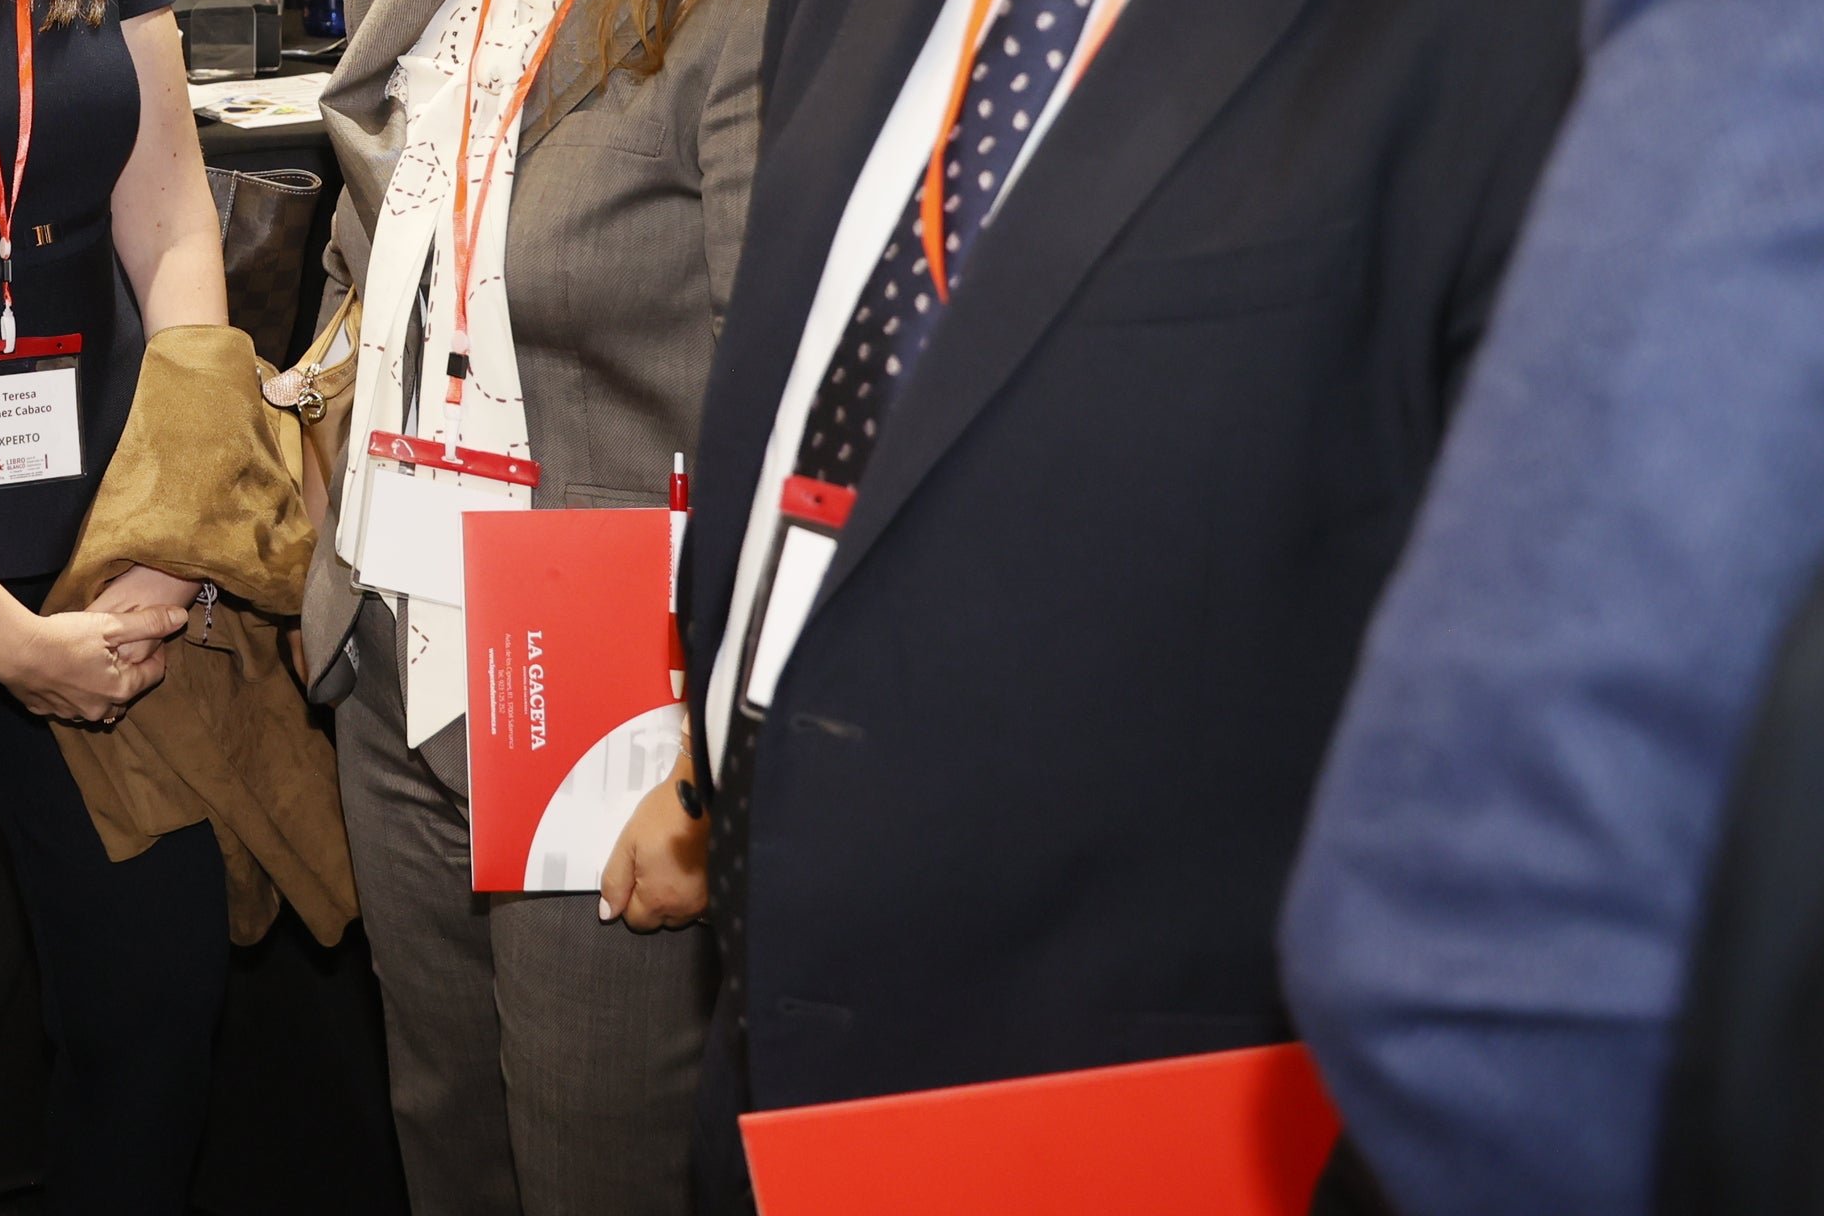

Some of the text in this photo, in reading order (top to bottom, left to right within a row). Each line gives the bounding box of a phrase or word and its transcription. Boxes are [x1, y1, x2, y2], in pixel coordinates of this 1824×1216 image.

[2, 391, 37, 402] Teresa
[15, 404, 52, 416] Cabaco
[6, 457, 26, 466] LIBRO
[527, 630, 546, 751] LA GACETA
